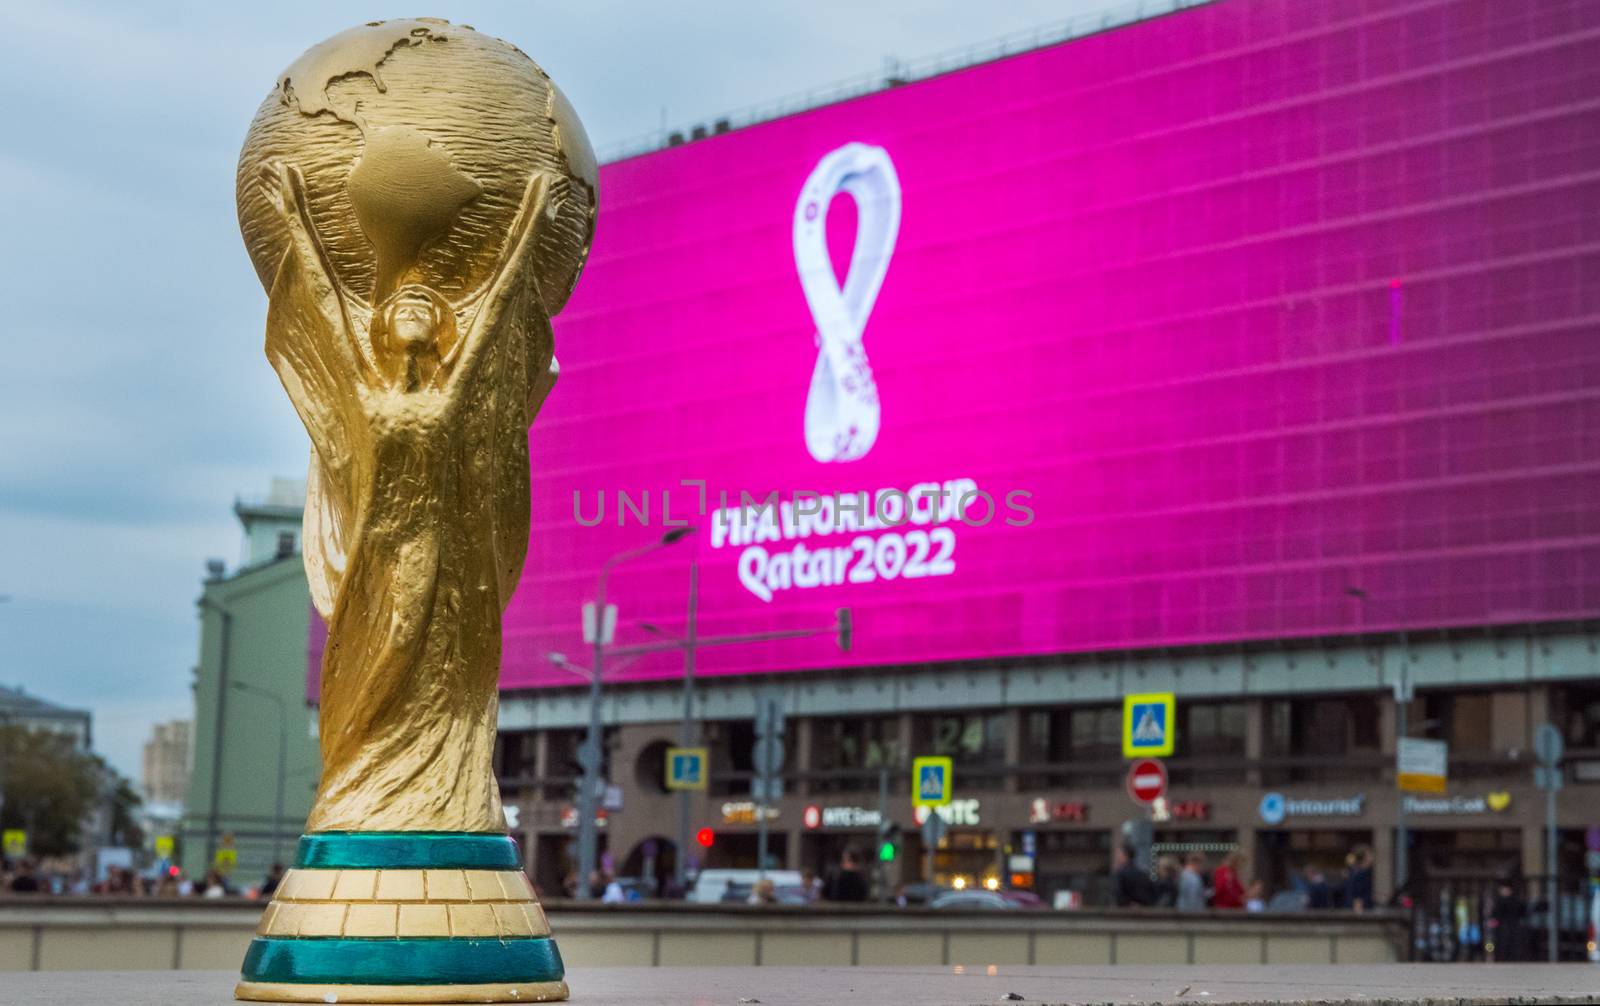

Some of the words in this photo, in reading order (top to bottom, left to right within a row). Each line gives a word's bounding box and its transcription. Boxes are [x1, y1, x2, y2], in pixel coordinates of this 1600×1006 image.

[710, 504, 782, 548] FIFA
[781, 487, 903, 541] WORLD
[904, 478, 977, 525] CUP
